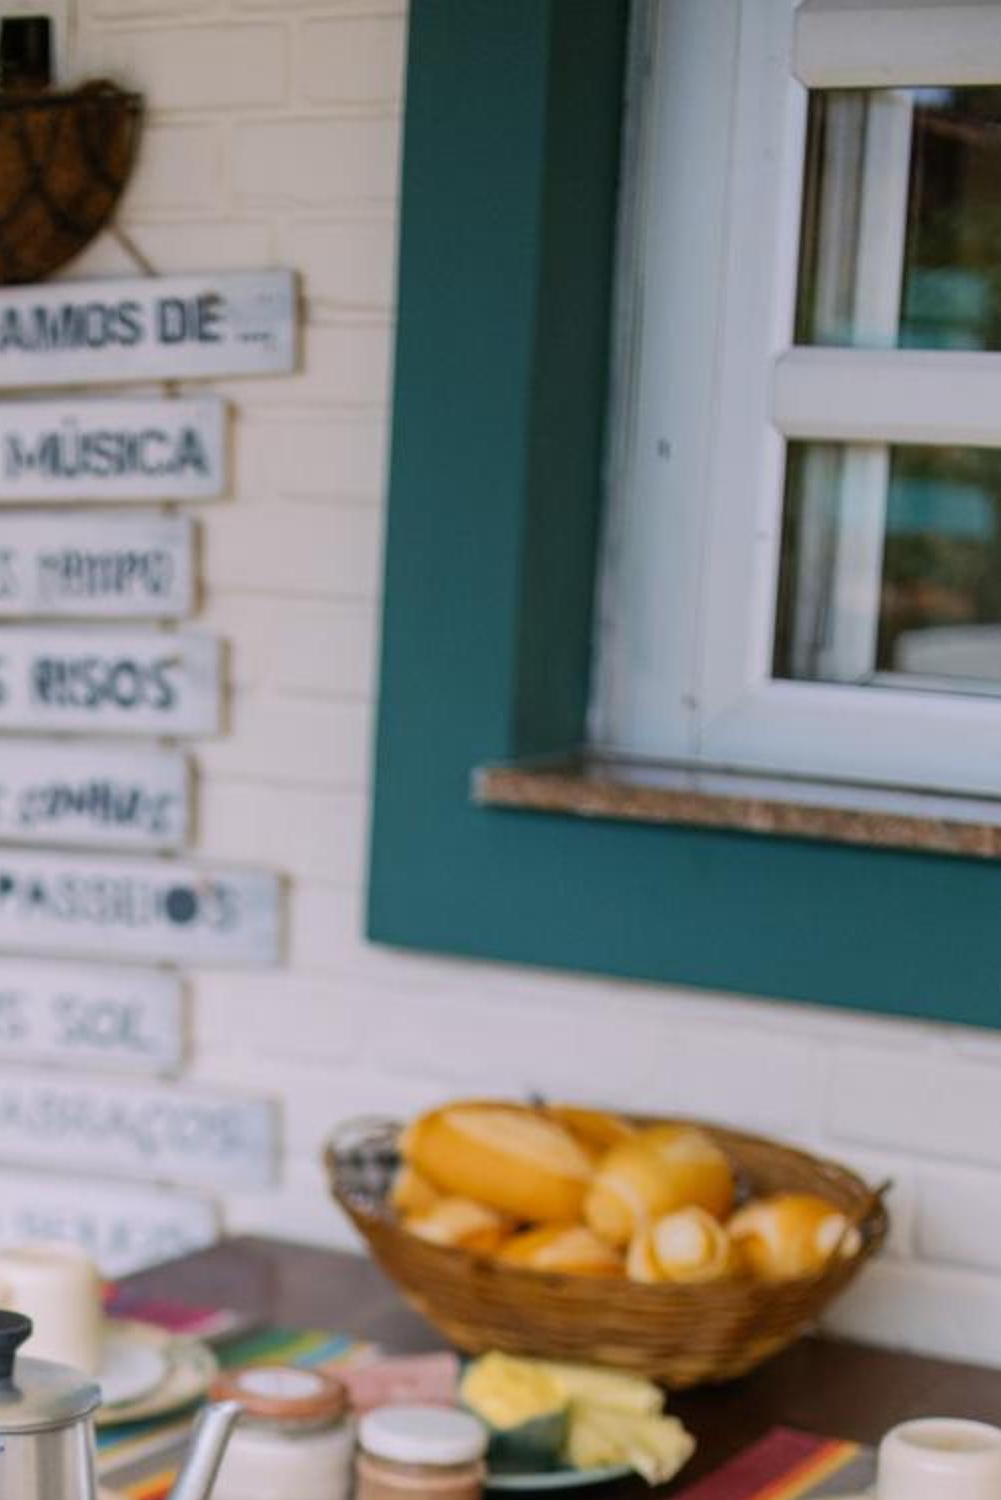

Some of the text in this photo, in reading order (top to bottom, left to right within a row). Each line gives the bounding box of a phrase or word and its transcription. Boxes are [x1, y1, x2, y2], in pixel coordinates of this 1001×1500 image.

[156, 296, 225, 344] DE
[5, 417, 211, 480] MÚSICA
[30, 656, 181, 710] RISOS
